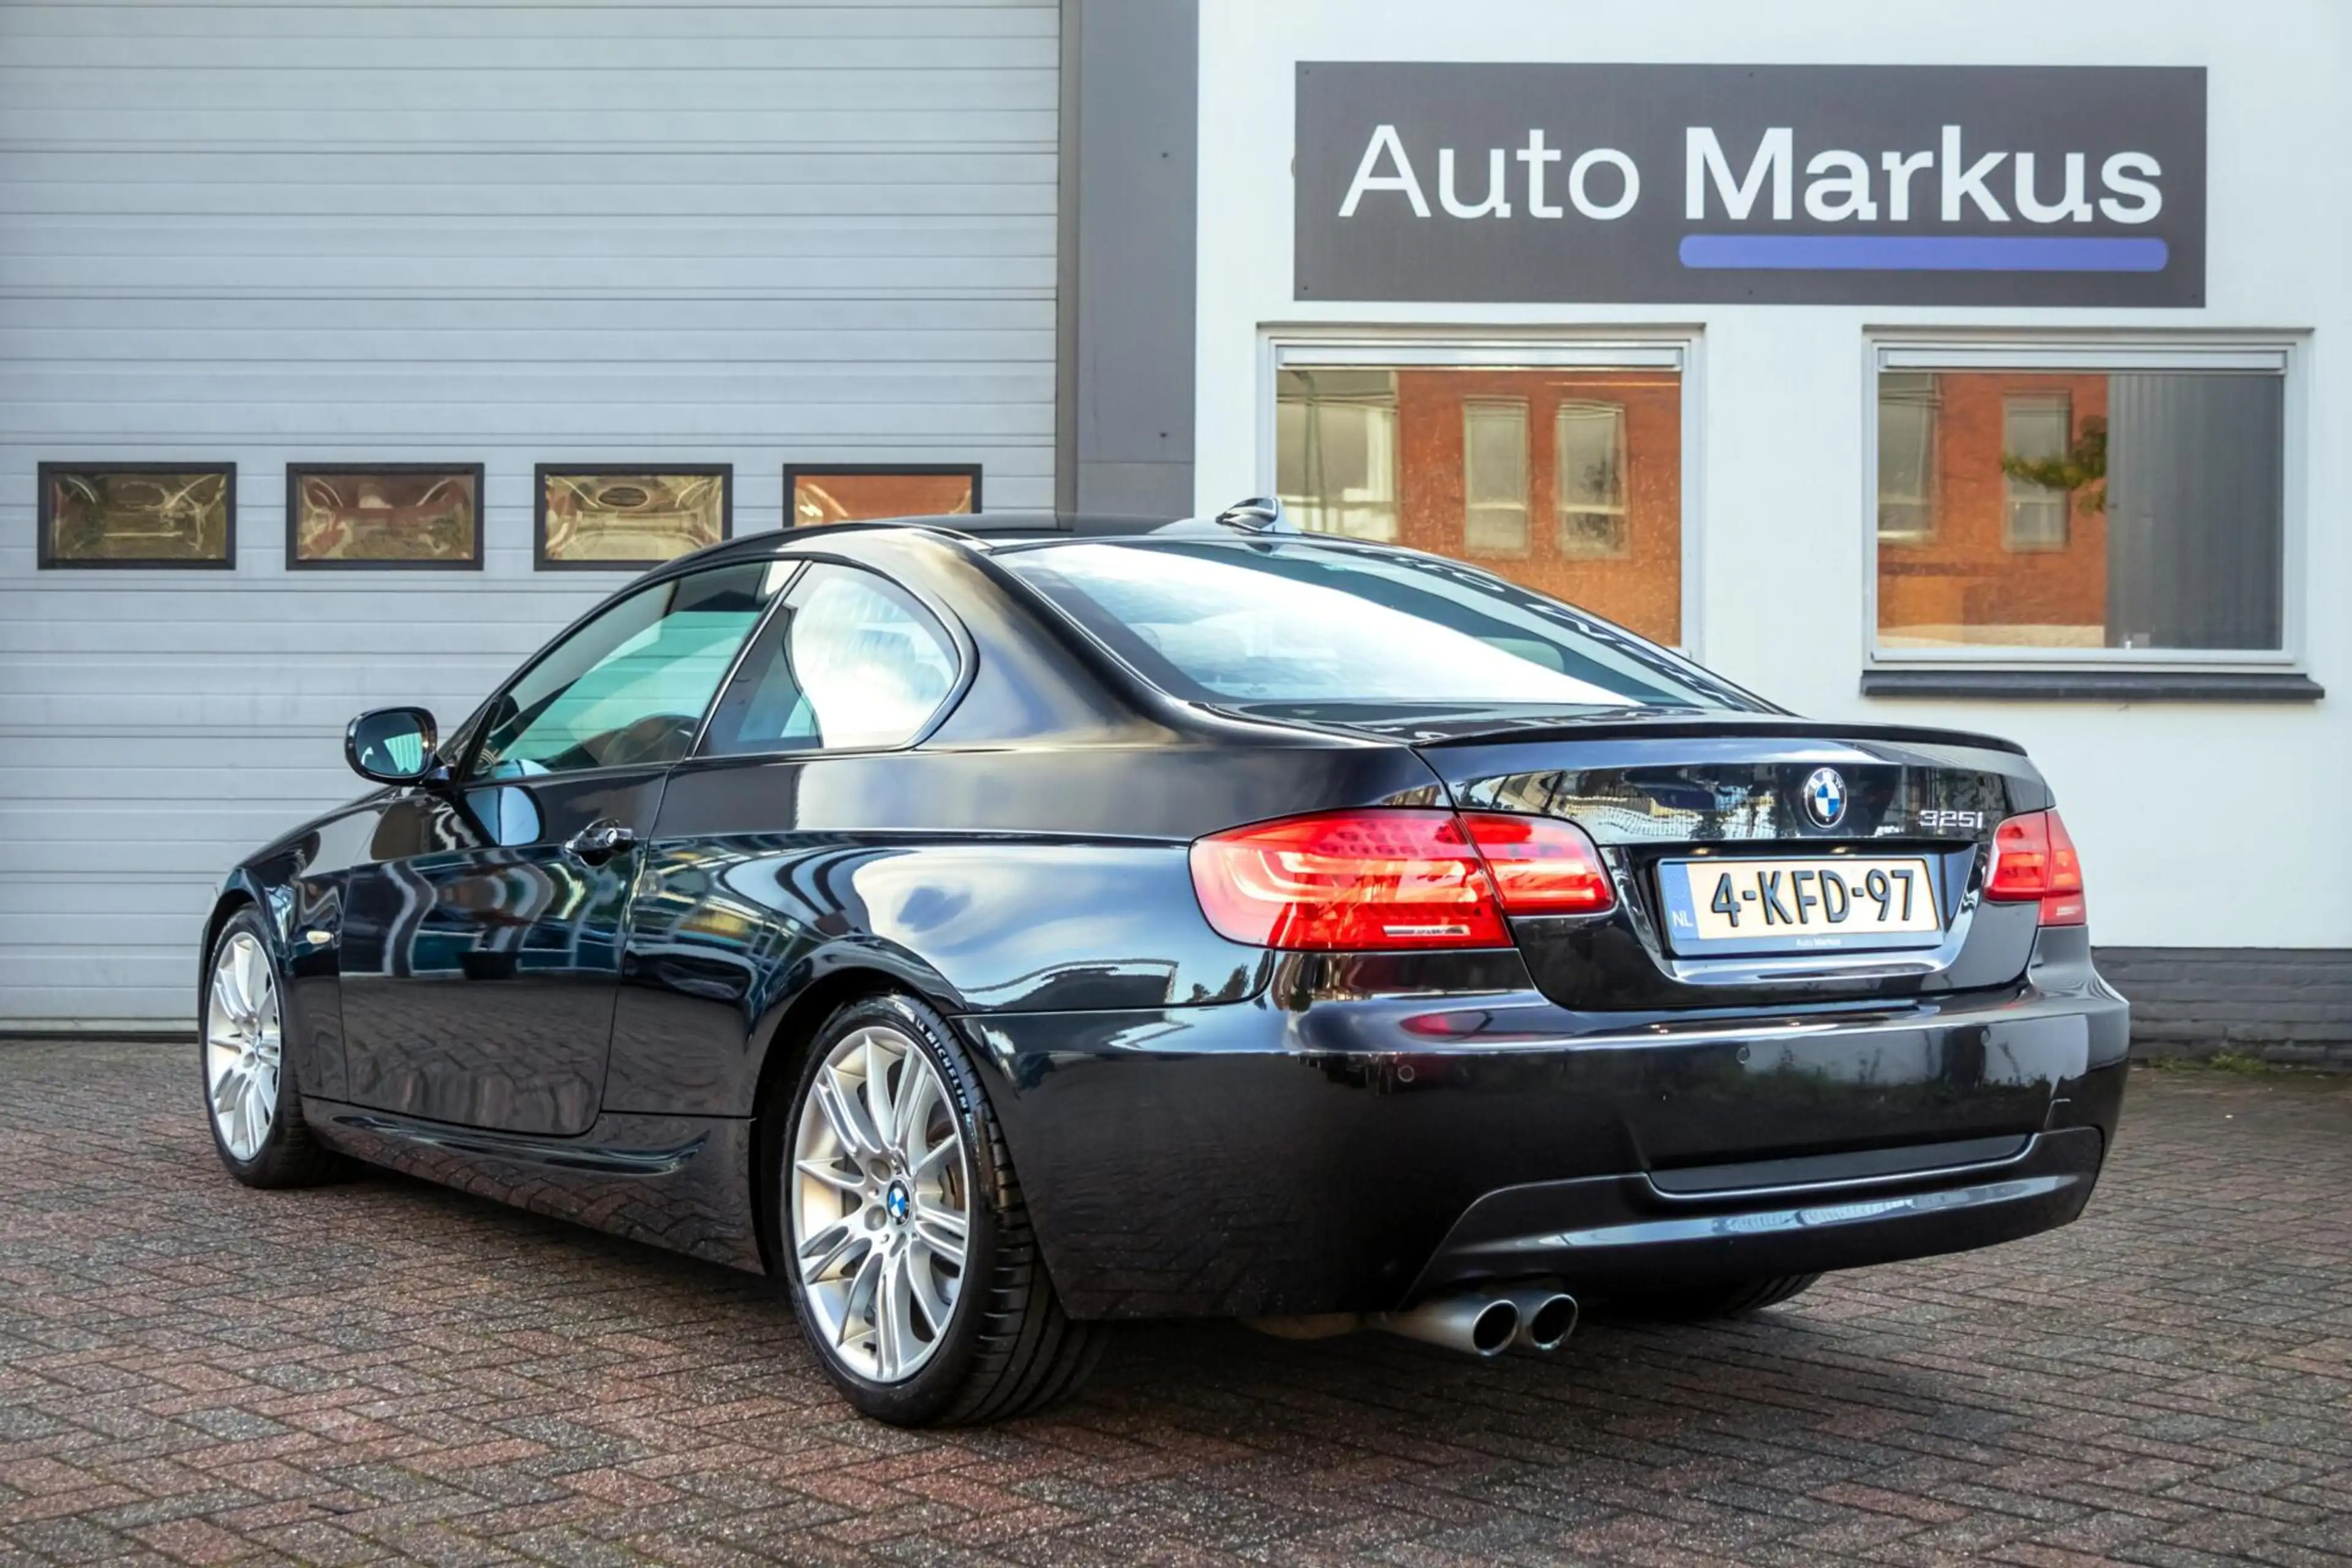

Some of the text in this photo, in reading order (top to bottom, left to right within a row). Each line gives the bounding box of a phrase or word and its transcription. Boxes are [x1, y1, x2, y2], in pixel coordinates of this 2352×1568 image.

[1338, 124, 2162, 224] Auto Markus
[1673, 911, 1693, 927] NL
[1711, 869, 1914, 927] 4-KFD-97
[925, 1031, 968, 1109] MICHELIN
